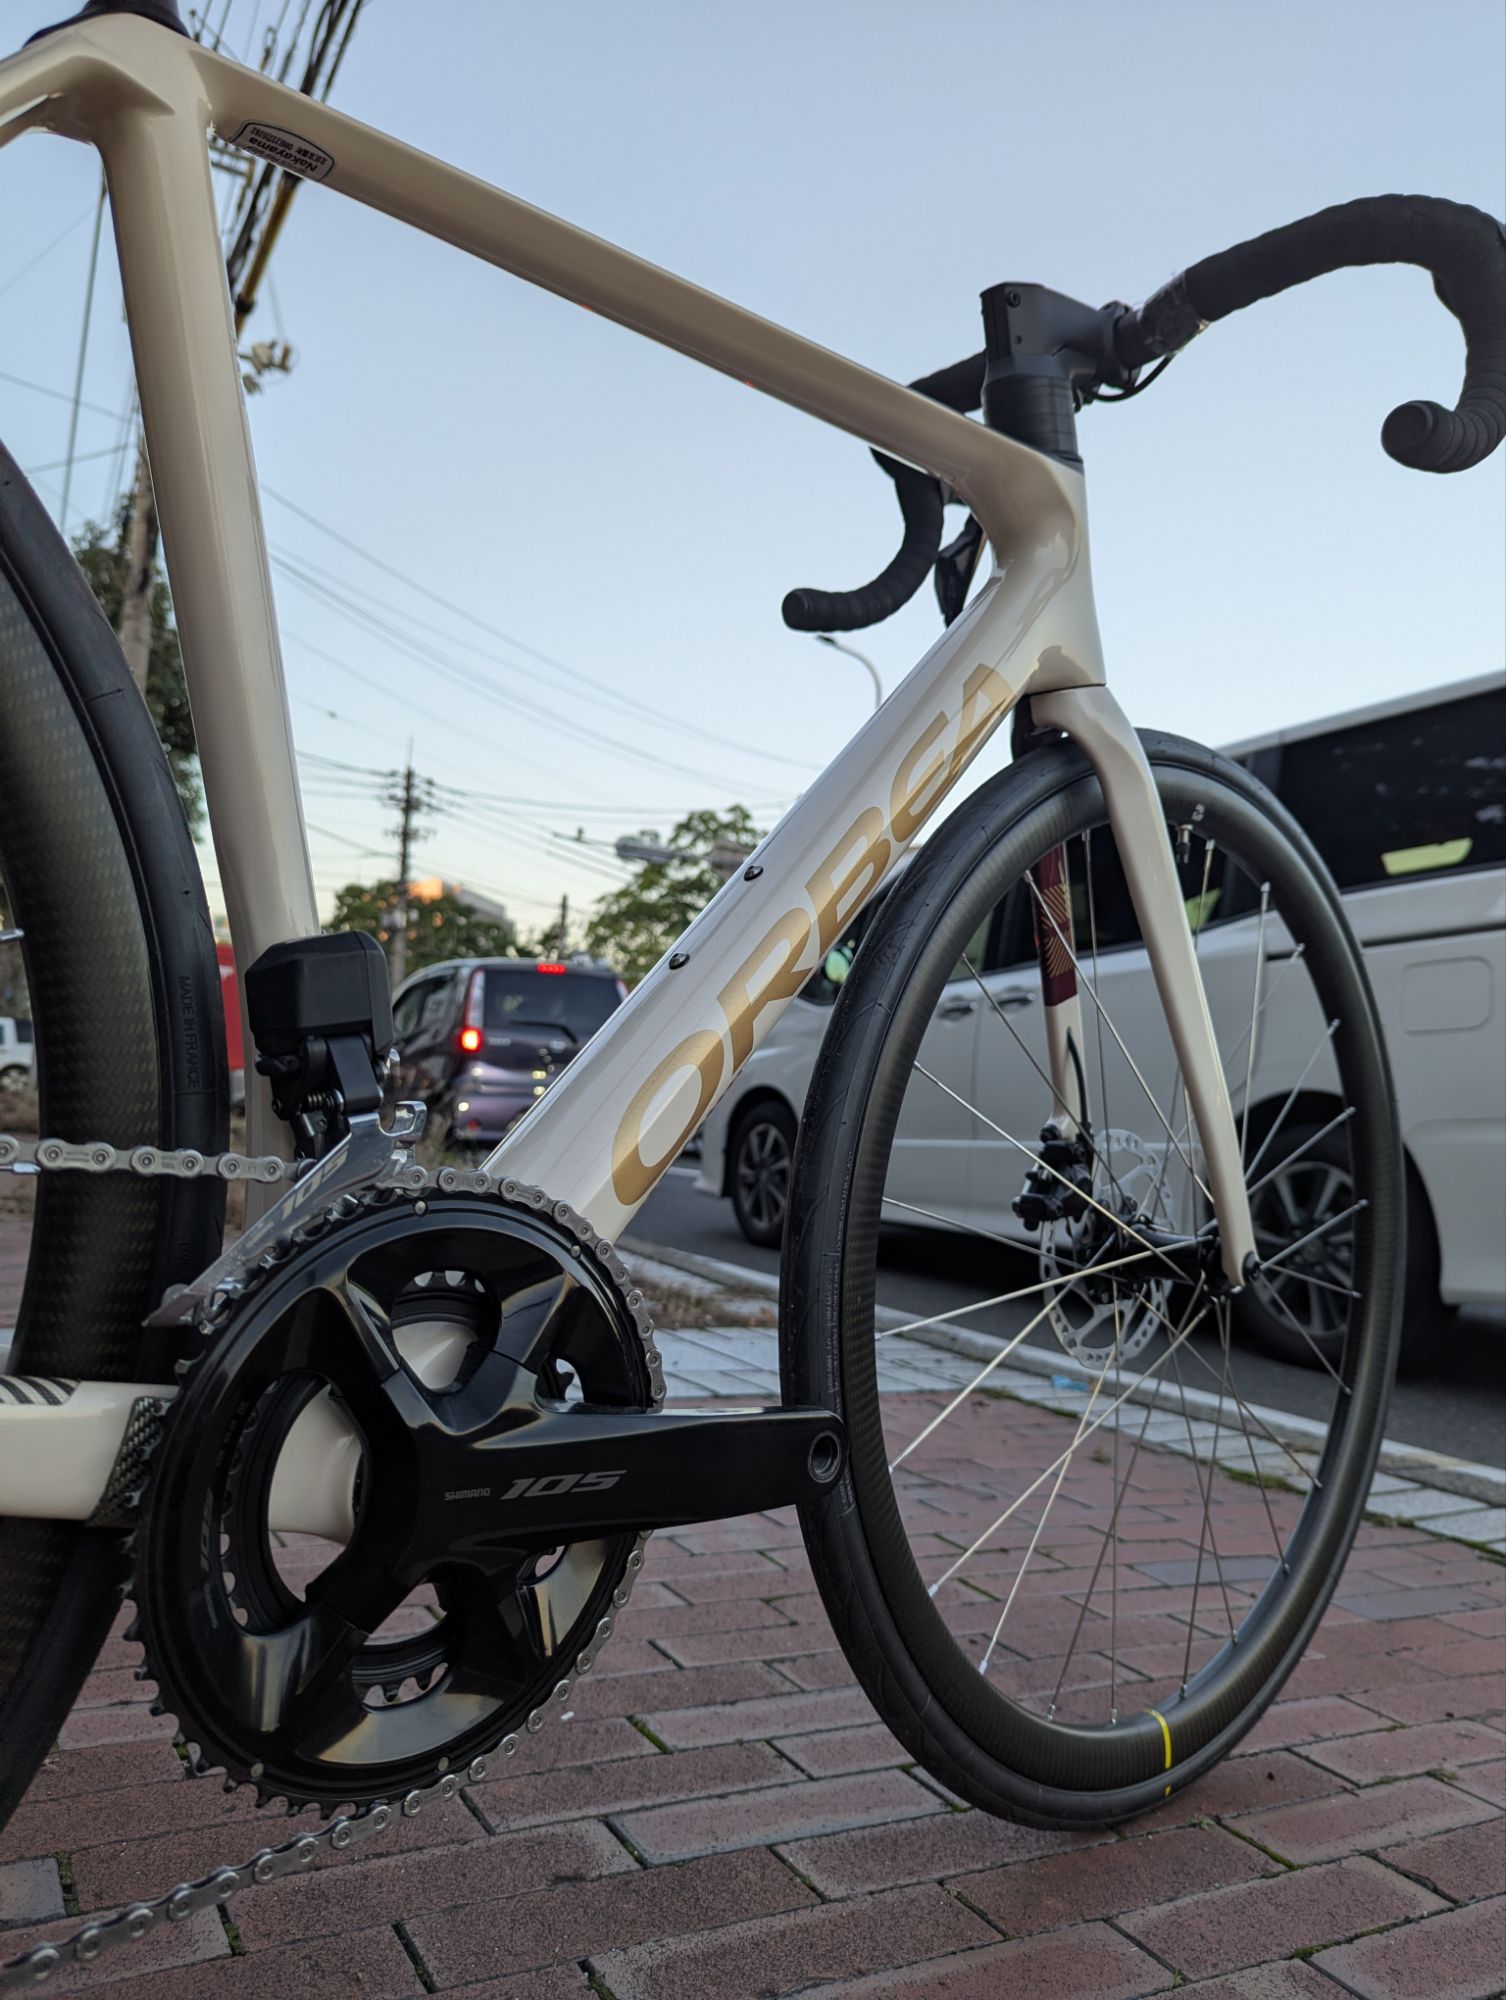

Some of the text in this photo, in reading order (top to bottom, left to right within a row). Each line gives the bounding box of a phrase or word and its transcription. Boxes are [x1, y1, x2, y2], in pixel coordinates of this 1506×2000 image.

[249, 137, 319, 172] Nakayama
[612, 663, 1014, 1206] ORBEA
[178, 976, 194, 1017] MADE
[184, 1033, 200, 1089] FRANCE
[281, 1150, 349, 1220] 105
[444, 1469, 628, 1501] SHIMANO 105
